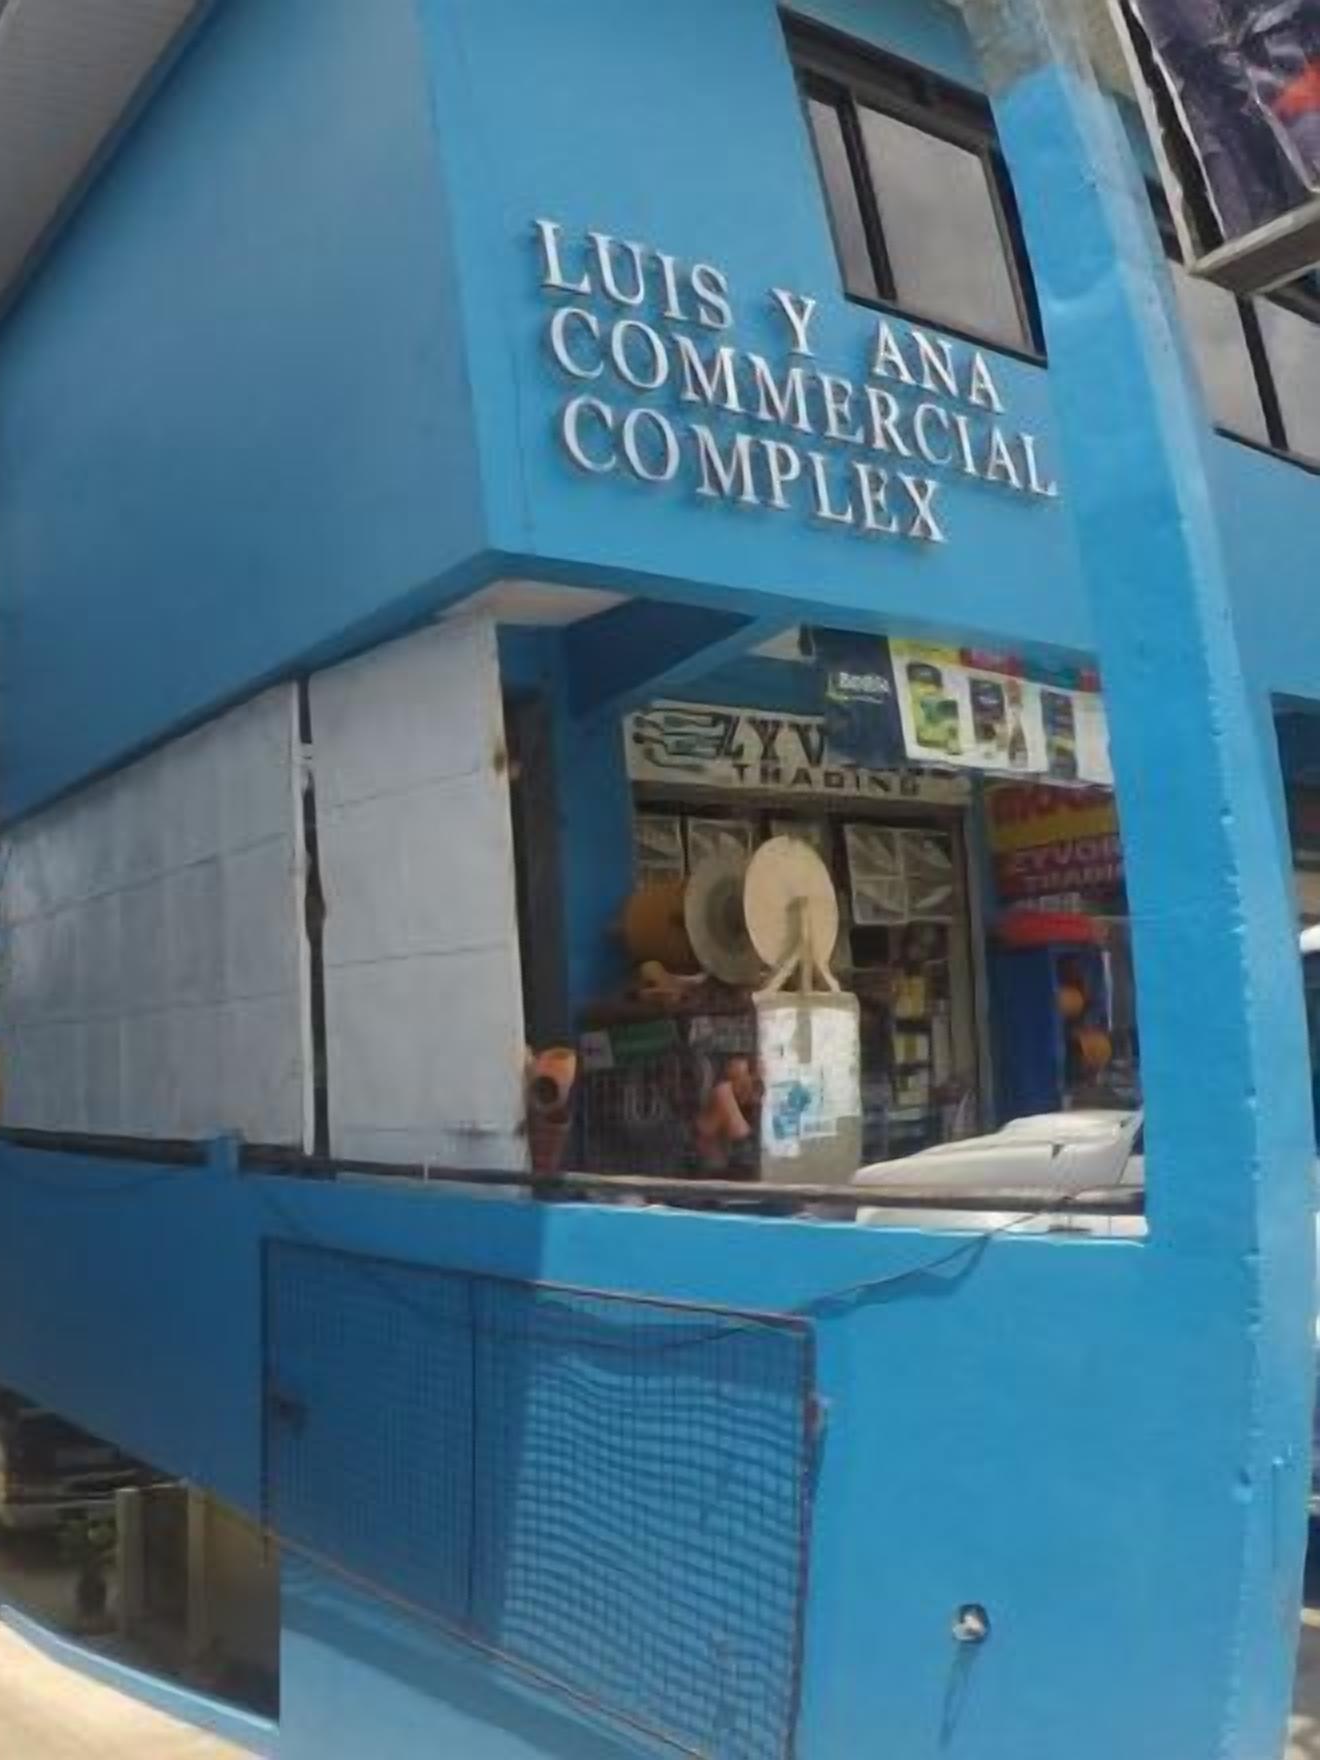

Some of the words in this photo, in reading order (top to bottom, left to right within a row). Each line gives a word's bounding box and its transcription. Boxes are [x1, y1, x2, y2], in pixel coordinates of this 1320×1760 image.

[535, 219, 733, 331] LUIS
[773, 288, 818, 357] Y
[873, 321, 1006, 415] ANA
[549, 307, 1059, 498] COMMERCIAL
[562, 395, 948, 543] COMPLEX
